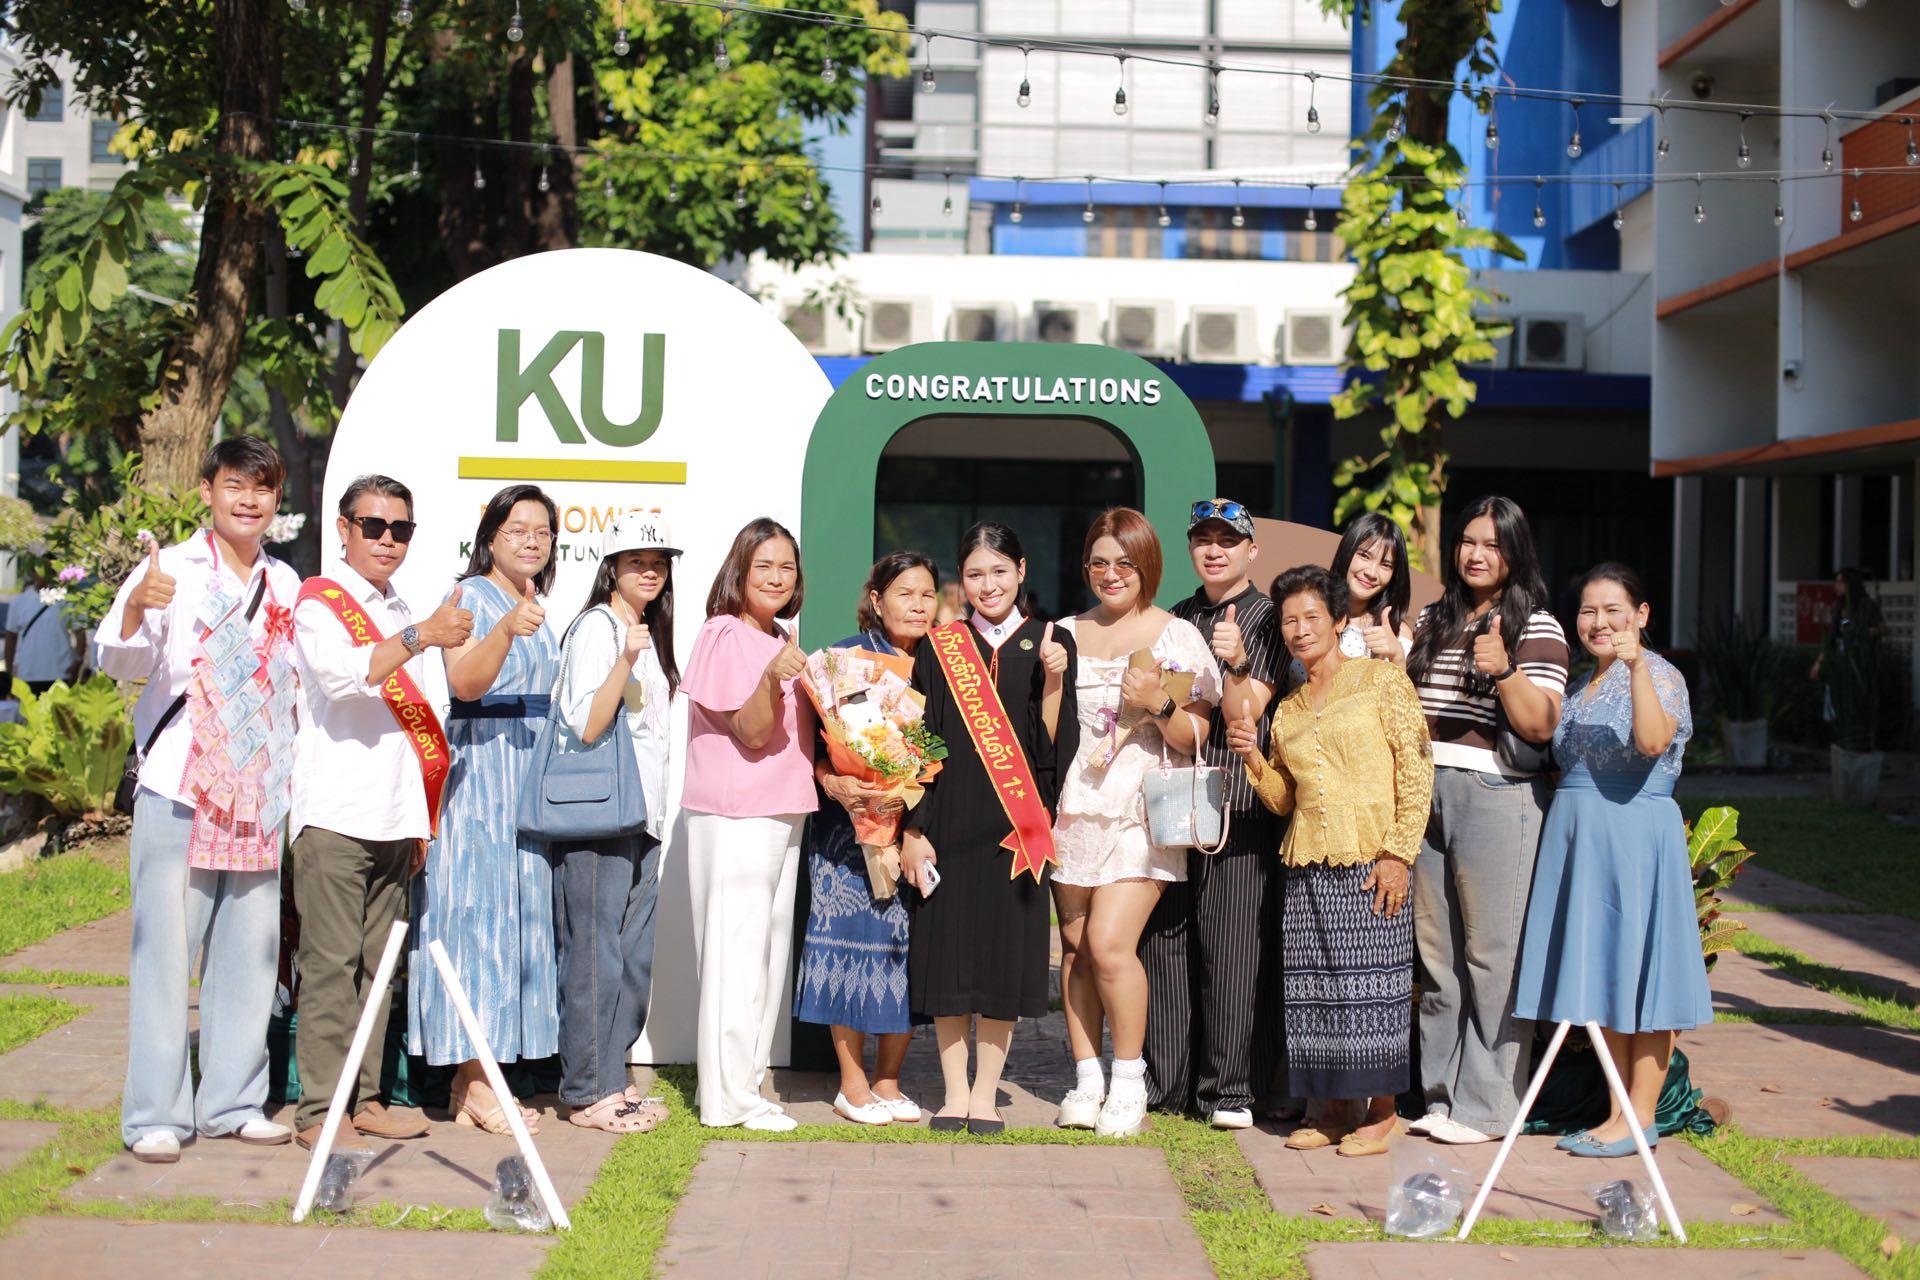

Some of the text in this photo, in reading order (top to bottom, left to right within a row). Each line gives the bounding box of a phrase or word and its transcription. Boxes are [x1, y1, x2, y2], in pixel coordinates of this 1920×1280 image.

[496, 328, 666, 447] KU
[865, 373, 1162, 405] CONGRATULATIONS
[640, 524, 657, 542] NY
[1002, 775, 1023, 789] 1
